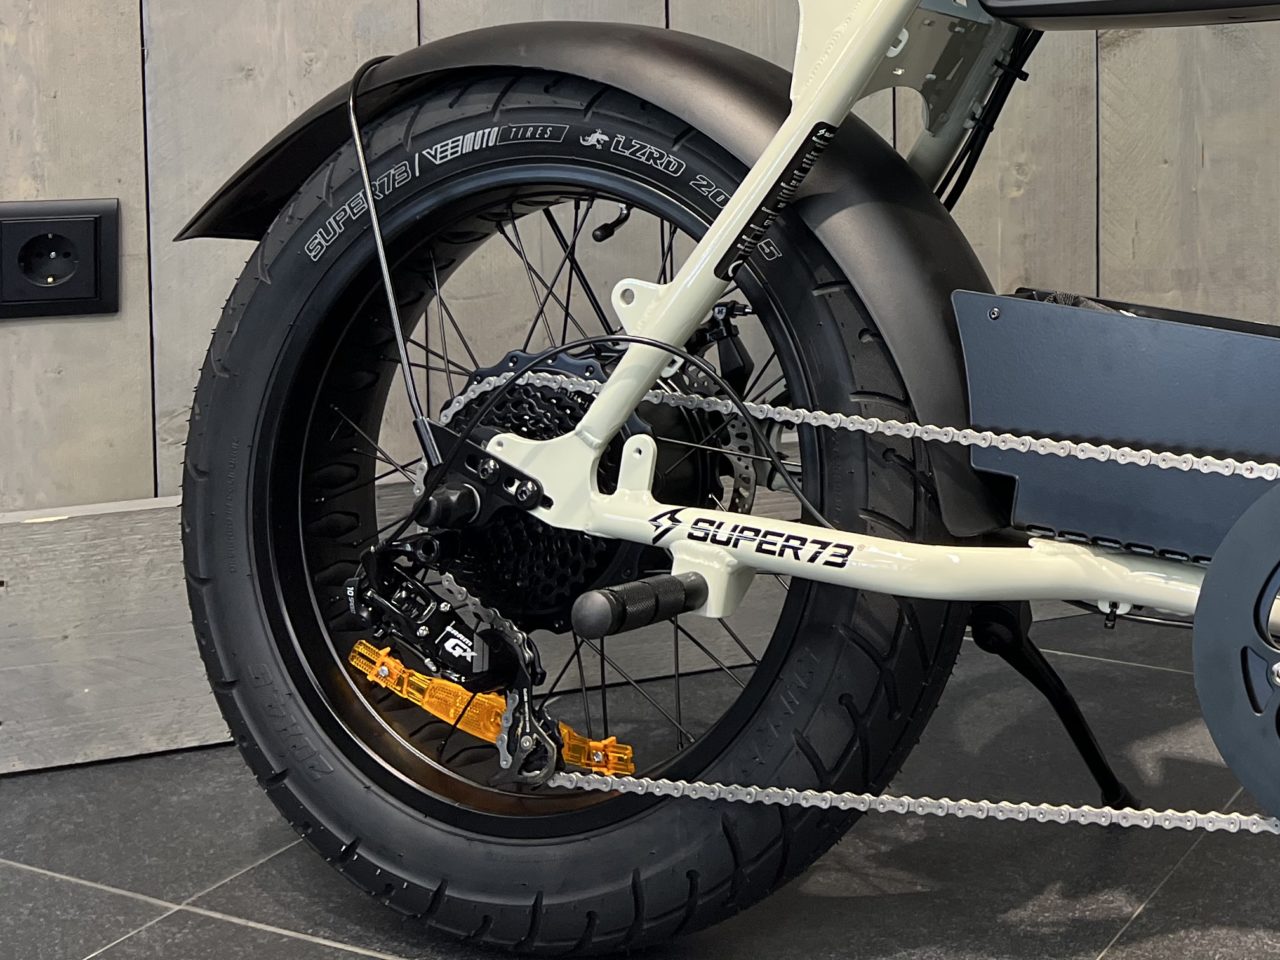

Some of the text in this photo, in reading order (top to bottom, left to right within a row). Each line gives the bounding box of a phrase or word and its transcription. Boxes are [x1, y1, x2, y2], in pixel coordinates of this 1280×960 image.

[610, 134, 686, 177] LZRD
[304, 160, 412, 262] SUPER73
[509, 126, 553, 140] TIRES
[686, 517, 855, 569] SUPER73
[346, 586, 355, 597] 10
[443, 637, 478, 663] GX
